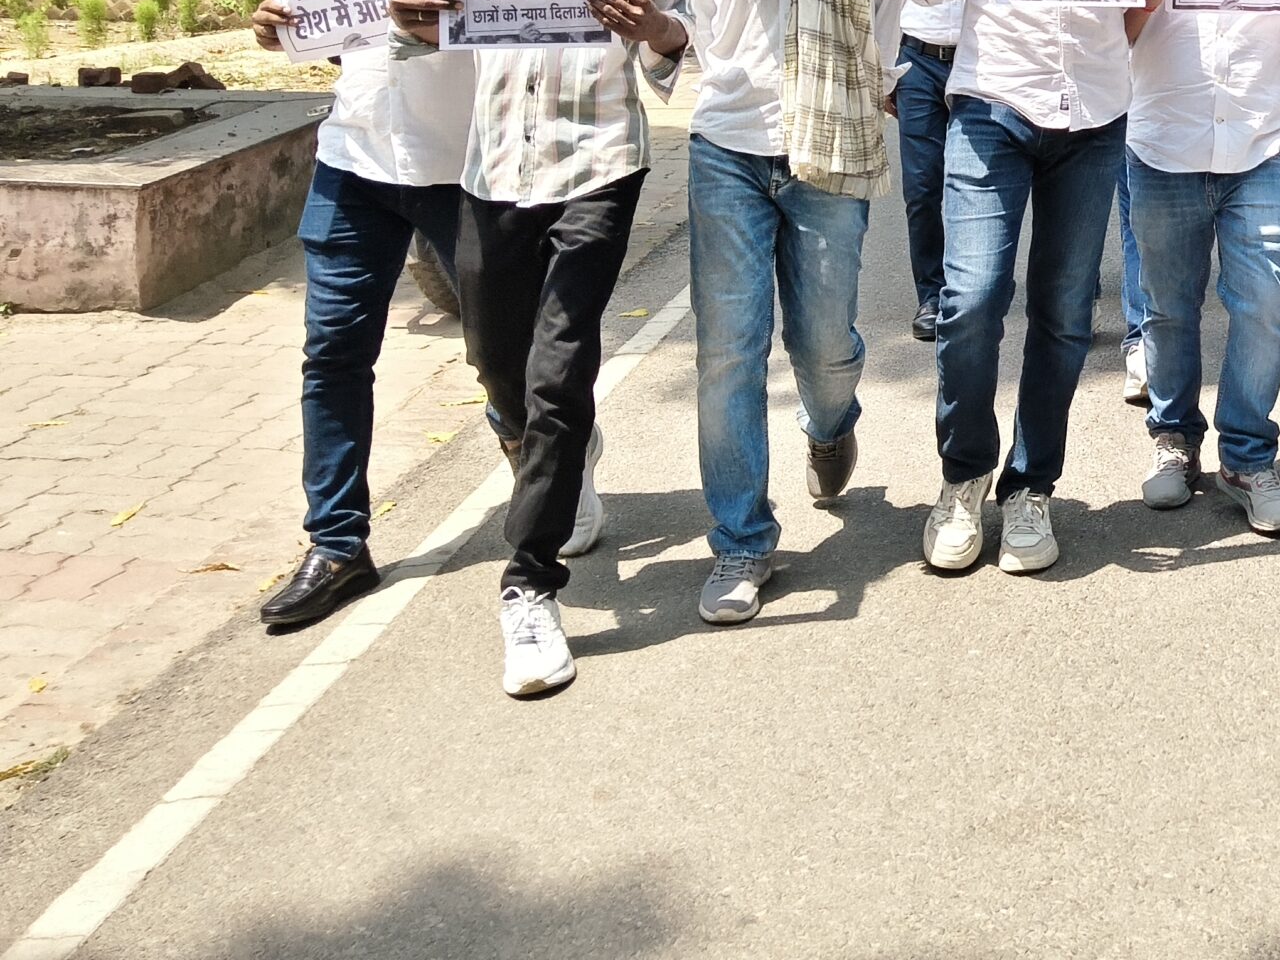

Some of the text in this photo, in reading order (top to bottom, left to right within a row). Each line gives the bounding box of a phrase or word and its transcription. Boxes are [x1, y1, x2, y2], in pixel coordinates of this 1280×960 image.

[294, 6, 331, 39] होश
[472, 5, 499, 24] छात्रों
[502, 4, 518, 22] को
[520, 8, 547, 22] न्याय
